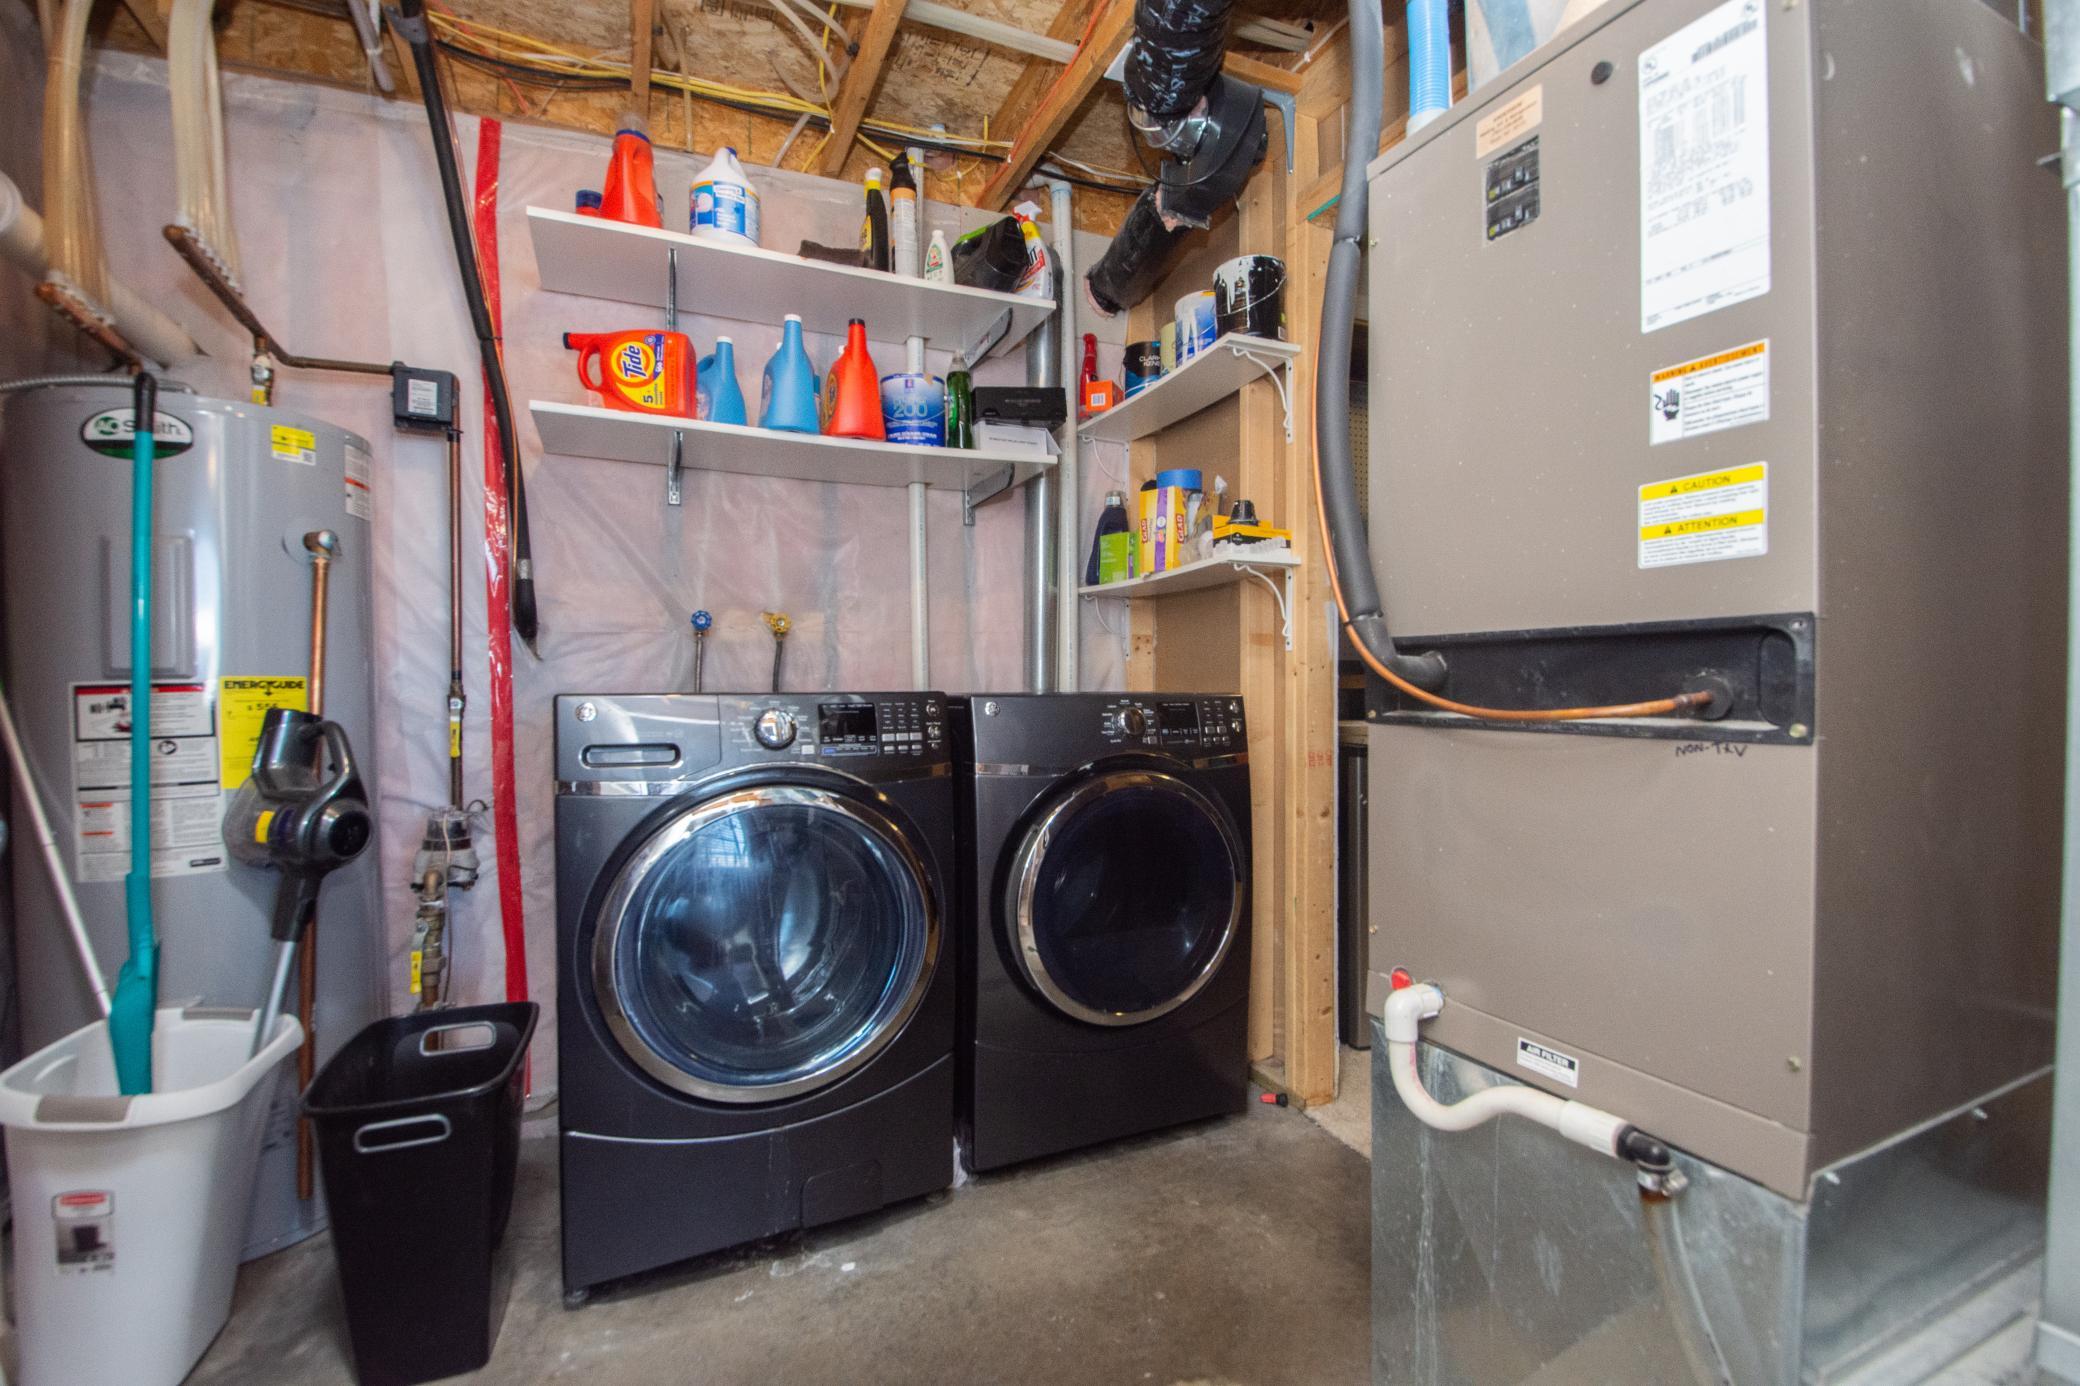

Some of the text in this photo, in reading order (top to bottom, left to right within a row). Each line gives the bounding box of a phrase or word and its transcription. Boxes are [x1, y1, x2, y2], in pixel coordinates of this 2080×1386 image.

[622, 345, 647, 378] Tide
[643, 394, 654, 404] 5
[893, 401, 928, 418] 200
[1682, 474, 1732, 491] CAUTION
[1177, 514, 1185, 542] GLAD
[1677, 515, 1738, 533] ATTENTION
[1525, 1044, 1541, 1056] AIR
[1541, 1048, 1570, 1069] FILTER
